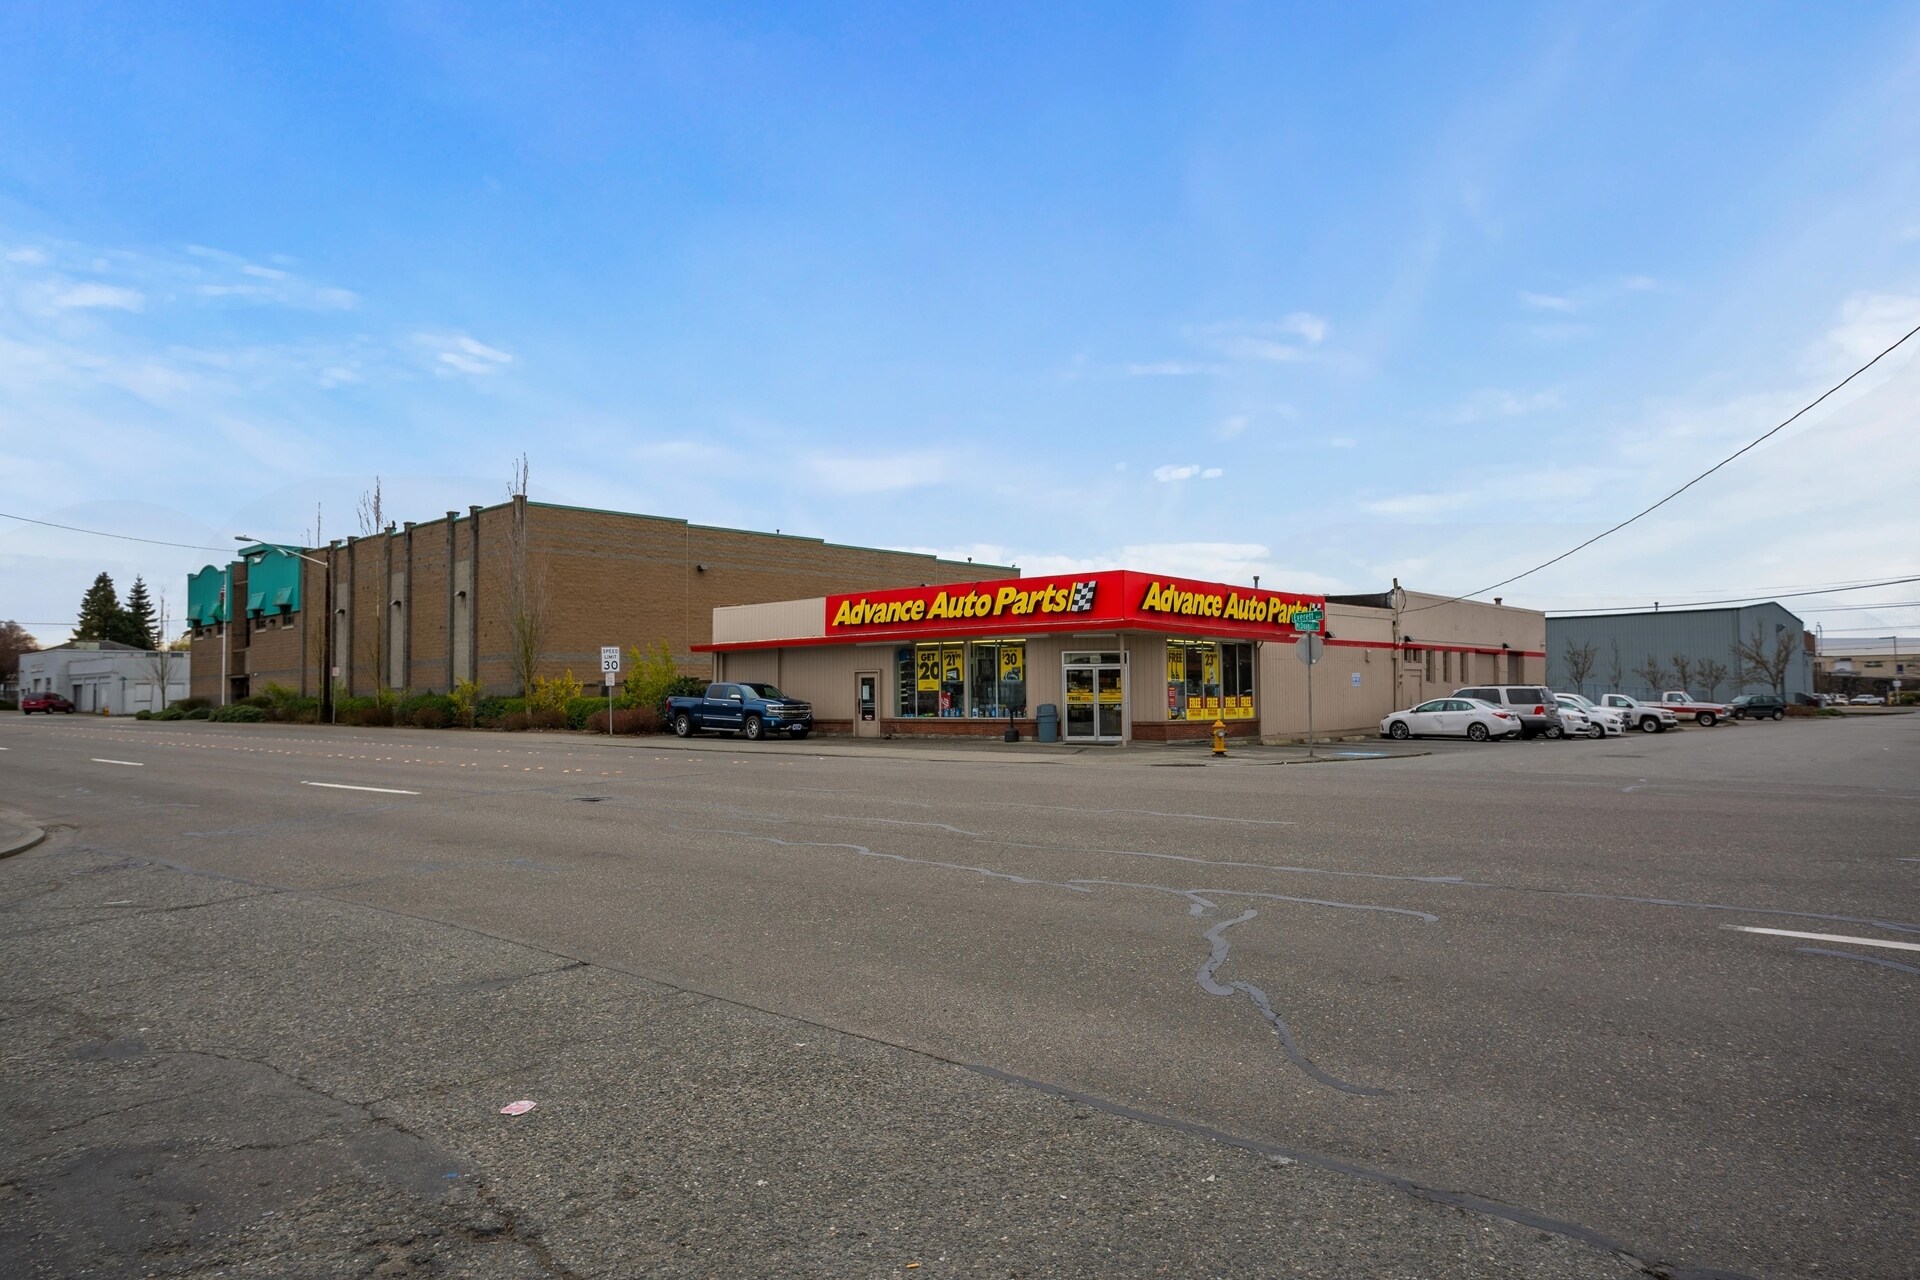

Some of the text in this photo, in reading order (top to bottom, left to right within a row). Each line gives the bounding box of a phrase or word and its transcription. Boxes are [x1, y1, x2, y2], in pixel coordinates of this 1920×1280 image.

[832, 584, 1070, 626] Advance Auto Parts
[1142, 582, 1222, 617] Advance
[1223, 592, 1266, 622] Auto
[1293, 612, 1314, 621] Everett
[921, 653, 936, 662] GET
[1002, 653, 1017, 666] $30
[1168, 653, 1183, 663] FREE
[603, 660, 618, 670] 30
[1189, 697, 1201, 708] FREE
[1206, 697, 1219, 708] FREE
[1225, 696, 1237, 707] FREE
